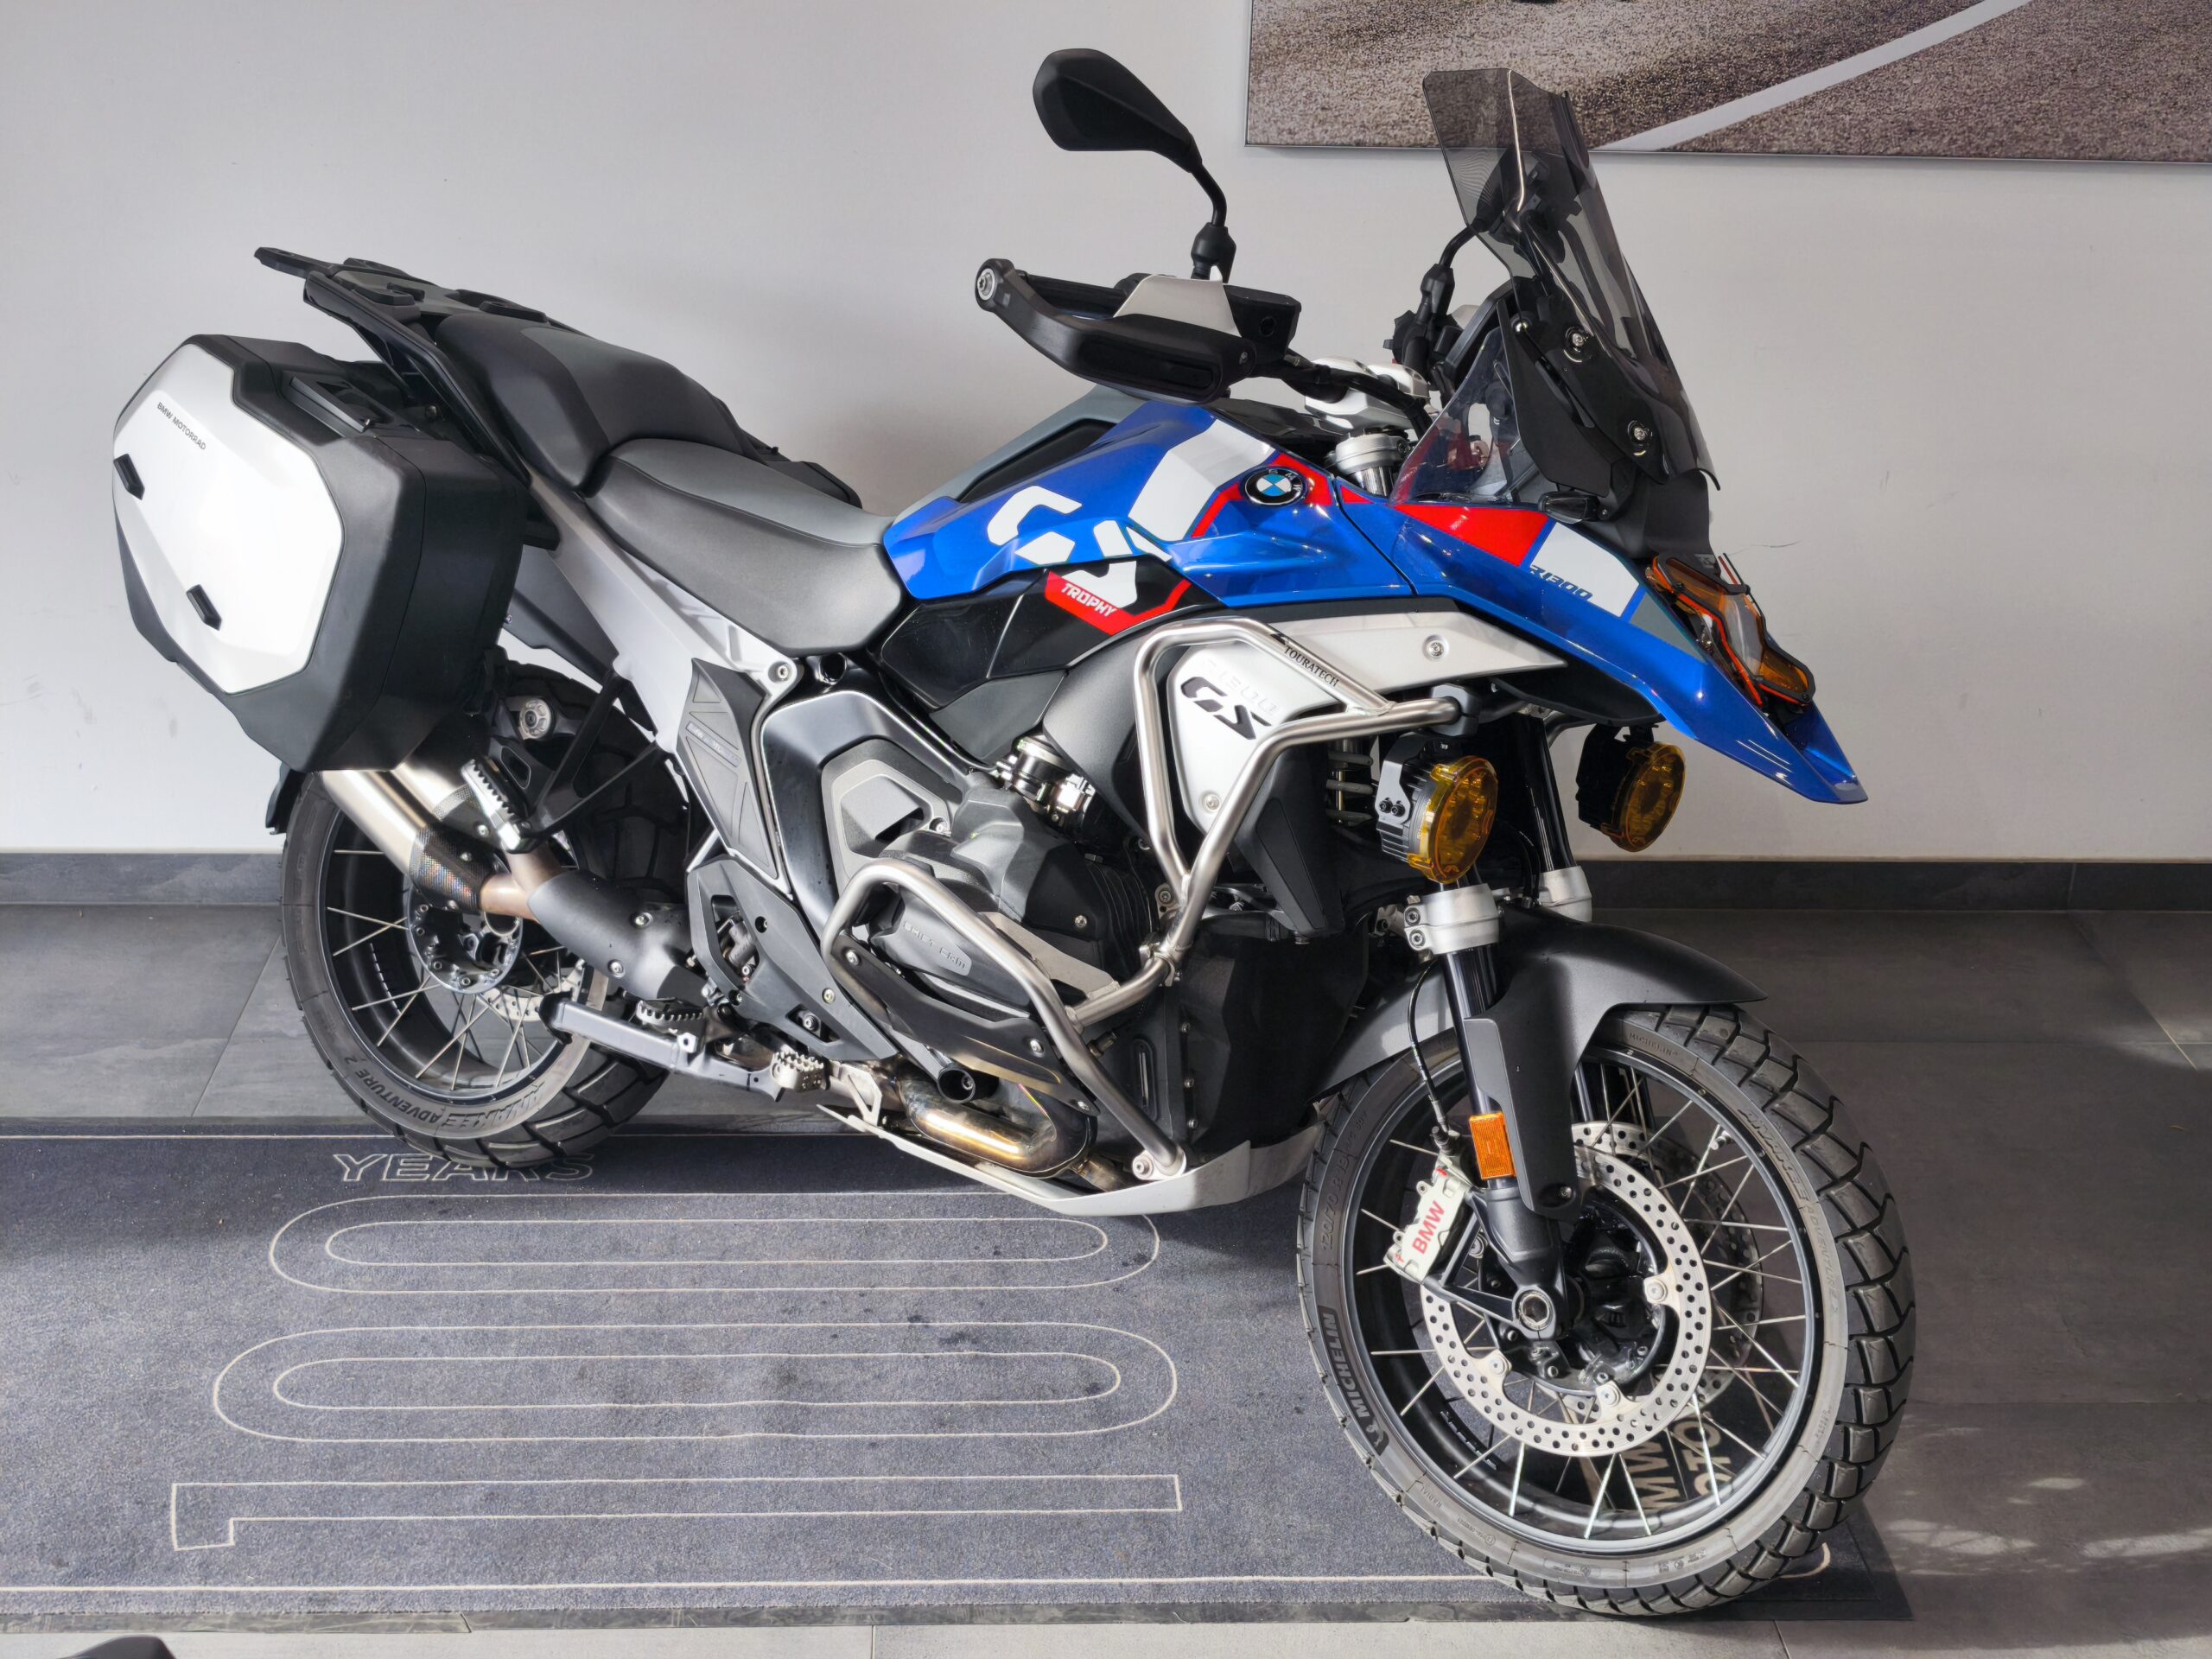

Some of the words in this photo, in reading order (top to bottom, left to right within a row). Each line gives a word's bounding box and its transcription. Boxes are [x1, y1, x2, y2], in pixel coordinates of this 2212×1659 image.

[157, 402, 173, 420] BMW
[174, 416, 207, 450] MOTORRAD
[1060, 582, 1118, 617] TROPHY
[1283, 645, 1340, 688] TOURATECH
[355, 1068, 441, 1124] ADVENTURE
[1411, 1199, 1446, 1255] BMW
[1801, 1205, 1840, 1297] ADVENTURE
[1322, 1313, 1371, 1419] MICHELIN
